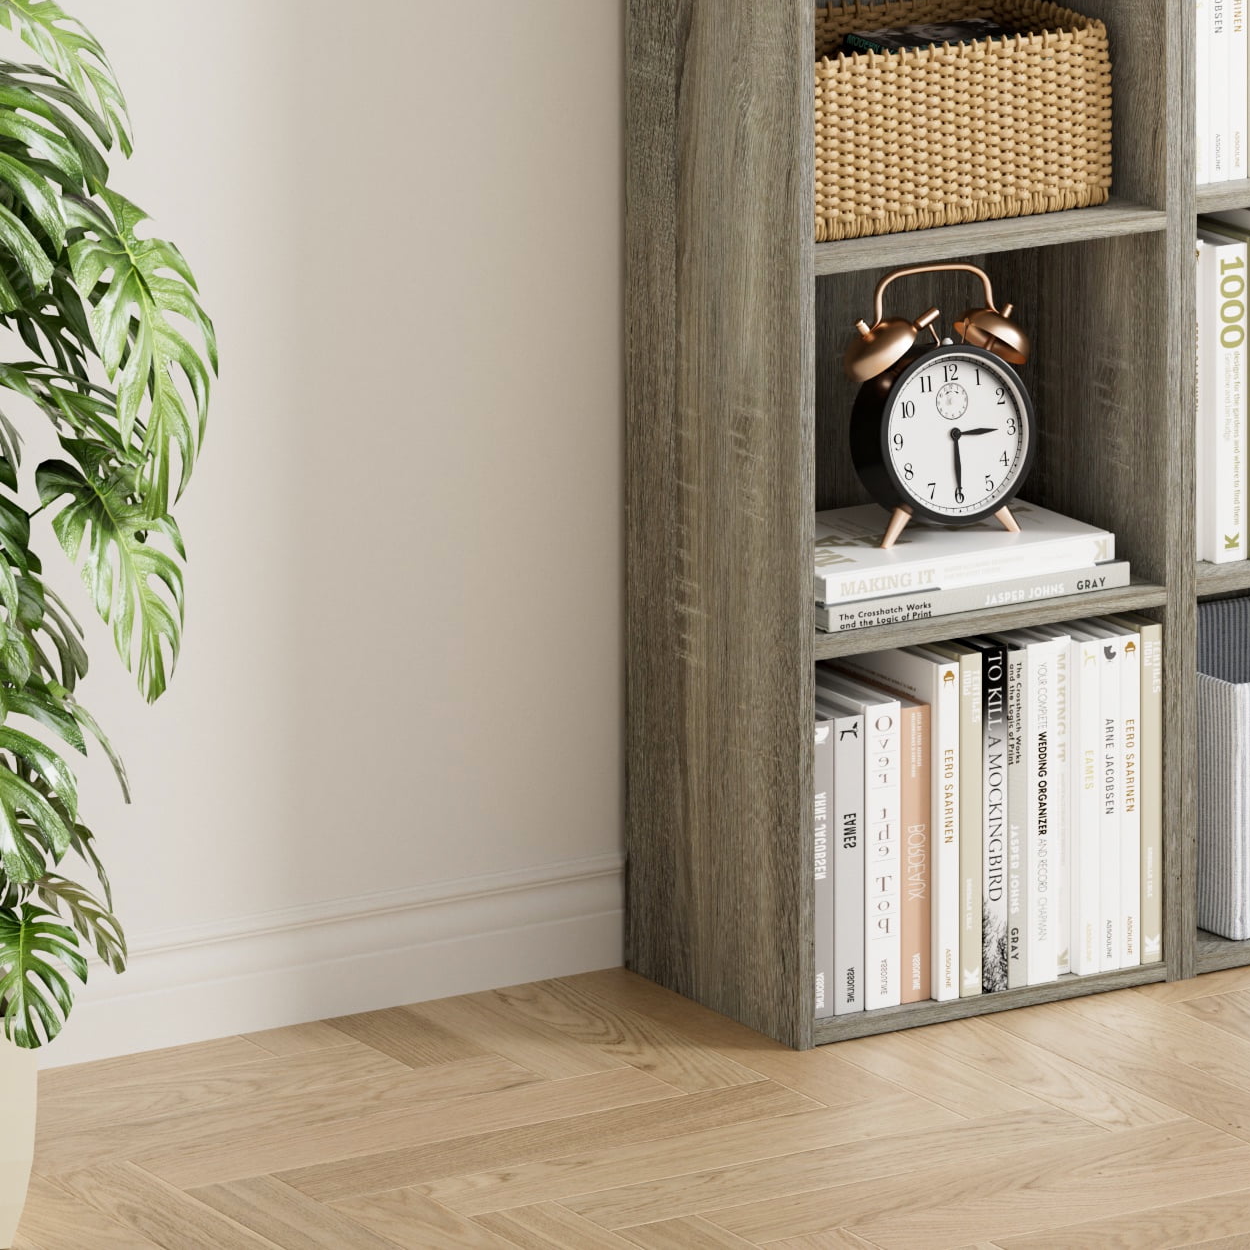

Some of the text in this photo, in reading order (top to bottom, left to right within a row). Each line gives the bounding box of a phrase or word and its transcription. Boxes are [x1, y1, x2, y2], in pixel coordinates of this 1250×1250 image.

[1219, 256, 1245, 349] 1000
[942, 363, 959, 383] 12
[974, 368, 982, 386] 1
[920, 375, 932, 393] 11
[995, 387, 1006, 406] 2
[900, 401, 915, 418] 10
[1006, 417, 1017, 437] 3
[893, 433, 904, 451] 9
[999, 451, 1009, 467] 4
[904, 462, 914, 481] 8
[927, 482, 937, 500] 7
[984, 474, 995, 492] 5
[955, 486, 965, 504] 6
[840, 569, 936, 598] MAKING IT
[984, 577, 1106, 607] JASPER JOHNS GRAY
[839, 602, 932, 621] The Crosshatch Works
[840, 610, 932, 630] and the Logic of Print
[1038, 731, 1048, 778] WEDDING
[1105, 718, 1114, 816] ARNE JACOBSEN
[1125, 718, 1134, 813] EERO SAARINEN
[987, 650, 1003, 902] TO KILL A MOCKINGBIRD
[944, 749, 953, 844] EERO SAARINEN
[1038, 780, 1048, 836] ORGANIZER
[1010, 825, 1020, 960] JASPER JOHNS GRAY
